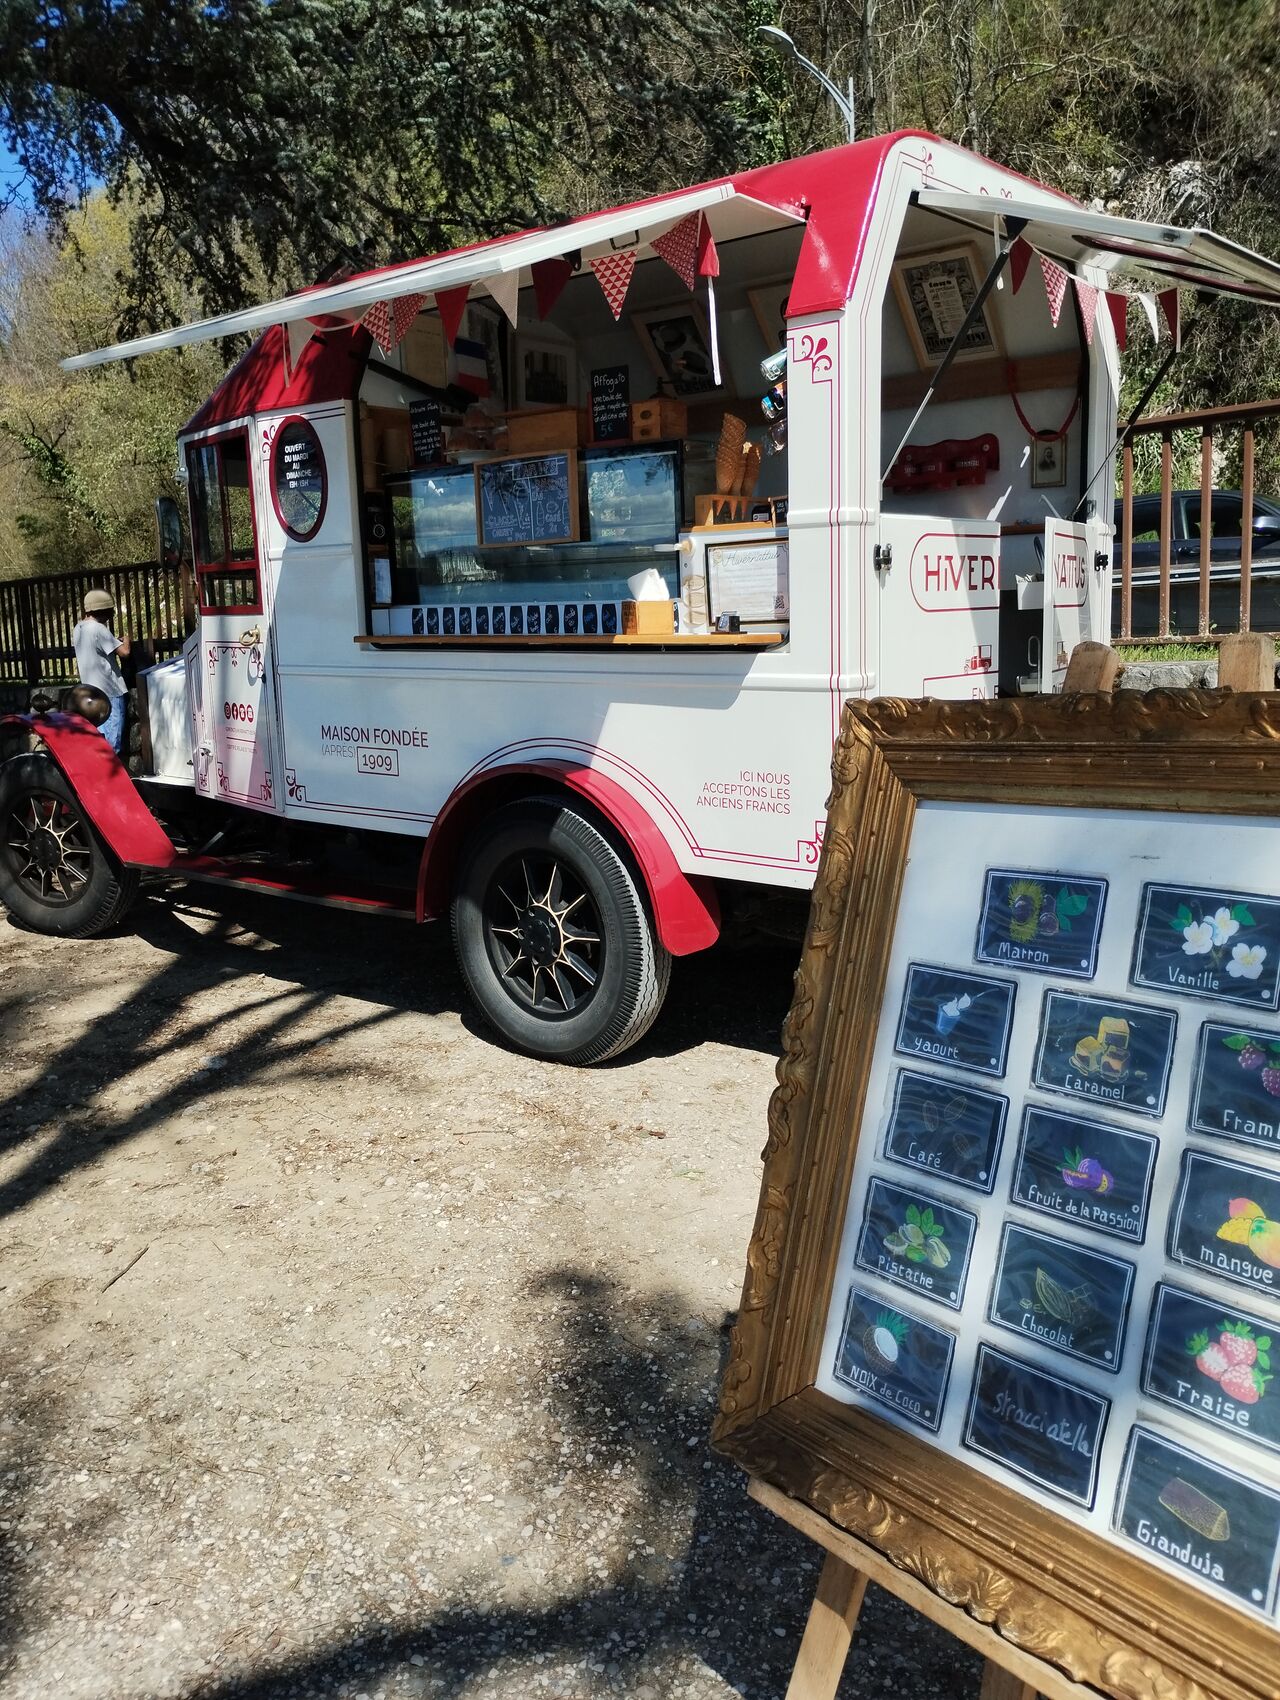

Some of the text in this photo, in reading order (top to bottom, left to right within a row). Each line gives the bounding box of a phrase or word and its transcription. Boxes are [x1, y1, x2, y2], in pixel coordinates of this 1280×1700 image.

[285, 444, 305, 453] OUVERT
[285, 455, 292, 463] DU
[286, 469, 312, 480] DIMANCHE
[293, 462, 300, 470] AU
[321, 725, 429, 748] MAISON FONDÉE
[362, 754, 393, 771] 1909
[740, 771, 791, 785] ICI NOUS
[703, 782, 791, 800] ACCEPTONS LES
[696, 796, 791, 815] ANCIENS FRANCS
[998, 942, 1049, 963] Marron
[1168, 966, 1219, 990] Vanille
[1065, 1074, 1125, 1101] Caramel
[1223, 1109, 1280, 1140] Fram
[908, 1142, 943, 1168] Café
[1065, 1202, 1078, 1214] de
[1081, 1203, 1090, 1218] la
[1093, 1207, 1140, 1232] Passion
[878, 1255, 933, 1289] Pistache
[1200, 1245, 1274, 1284] mangue
[1021, 1313, 1074, 1348] Chocolat
[880, 1383, 893, 1400] de
[1176, 1380, 1250, 1427] Fraise
[1136, 1519, 1225, 1582] Gianduja
